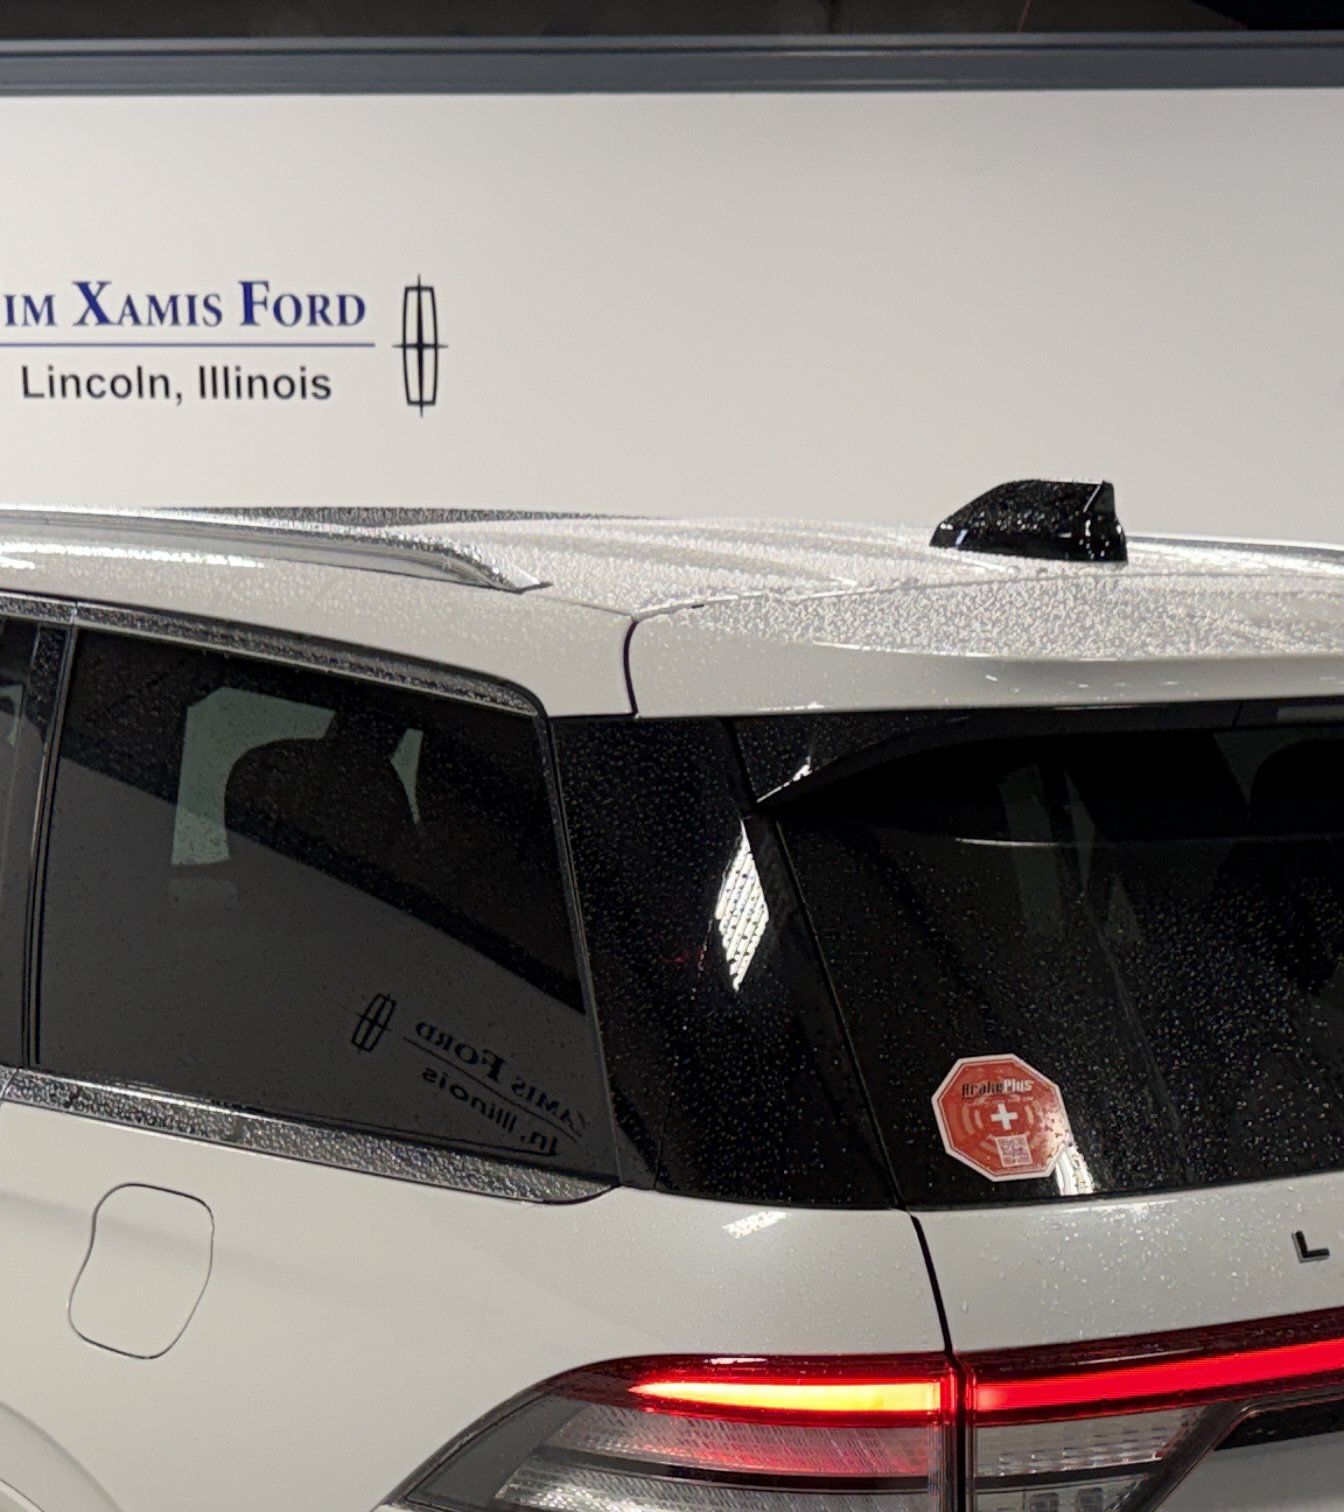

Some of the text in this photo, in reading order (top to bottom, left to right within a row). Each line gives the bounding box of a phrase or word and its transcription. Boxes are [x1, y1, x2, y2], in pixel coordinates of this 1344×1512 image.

[72, 280, 223, 328] XAMIS
[238, 280, 367, 328] FORD
[20, 364, 333, 406] Lincoln, Illinois
